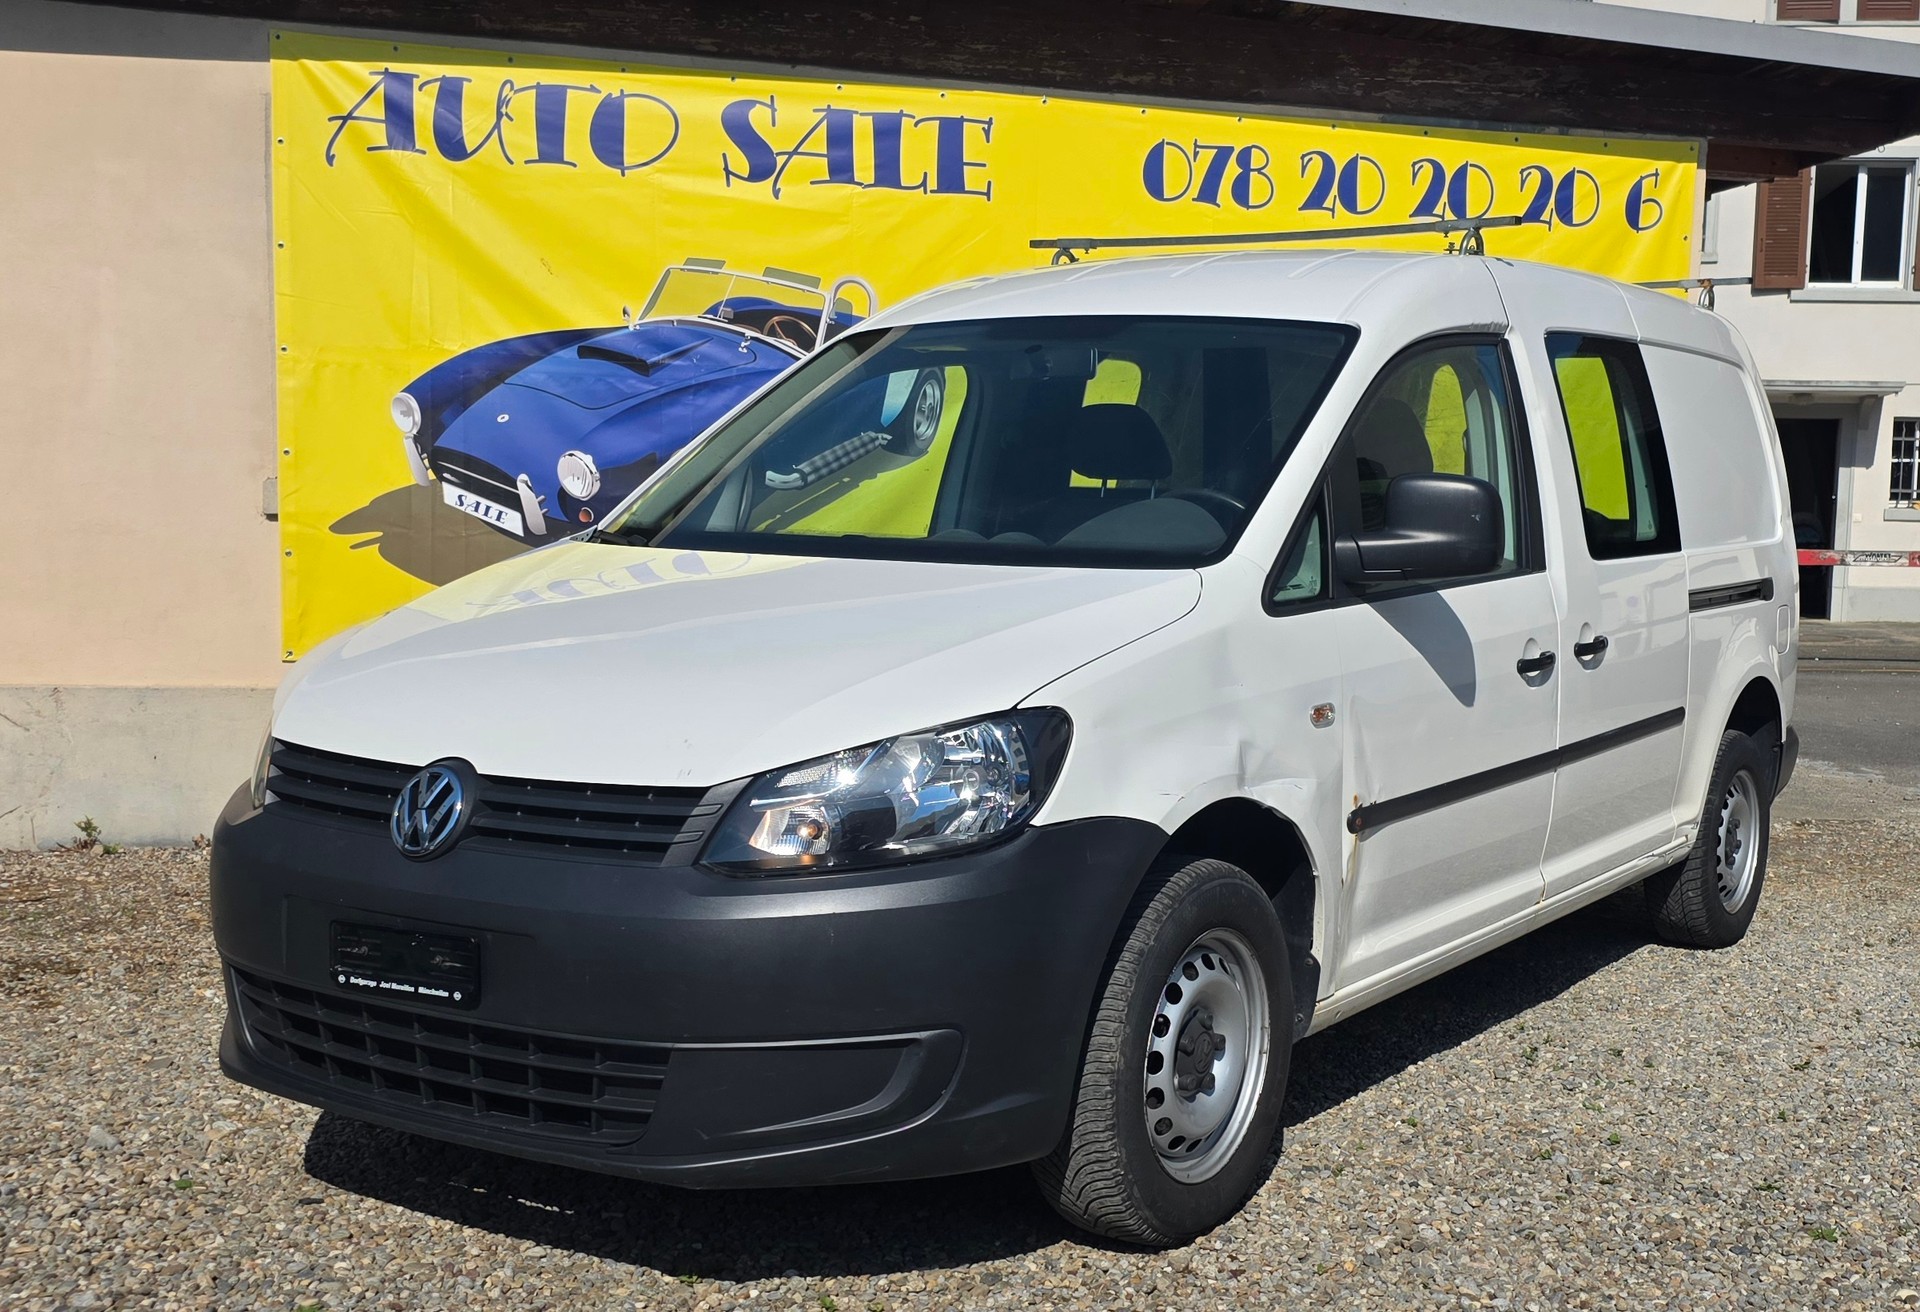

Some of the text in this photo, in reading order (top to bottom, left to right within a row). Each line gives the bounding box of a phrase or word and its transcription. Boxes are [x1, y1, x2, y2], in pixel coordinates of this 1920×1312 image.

[325, 67, 993, 200] AUTO SALE
[1142, 138, 1664, 233] 078 20 20 20 6
[454, 493, 509, 525] SALE
